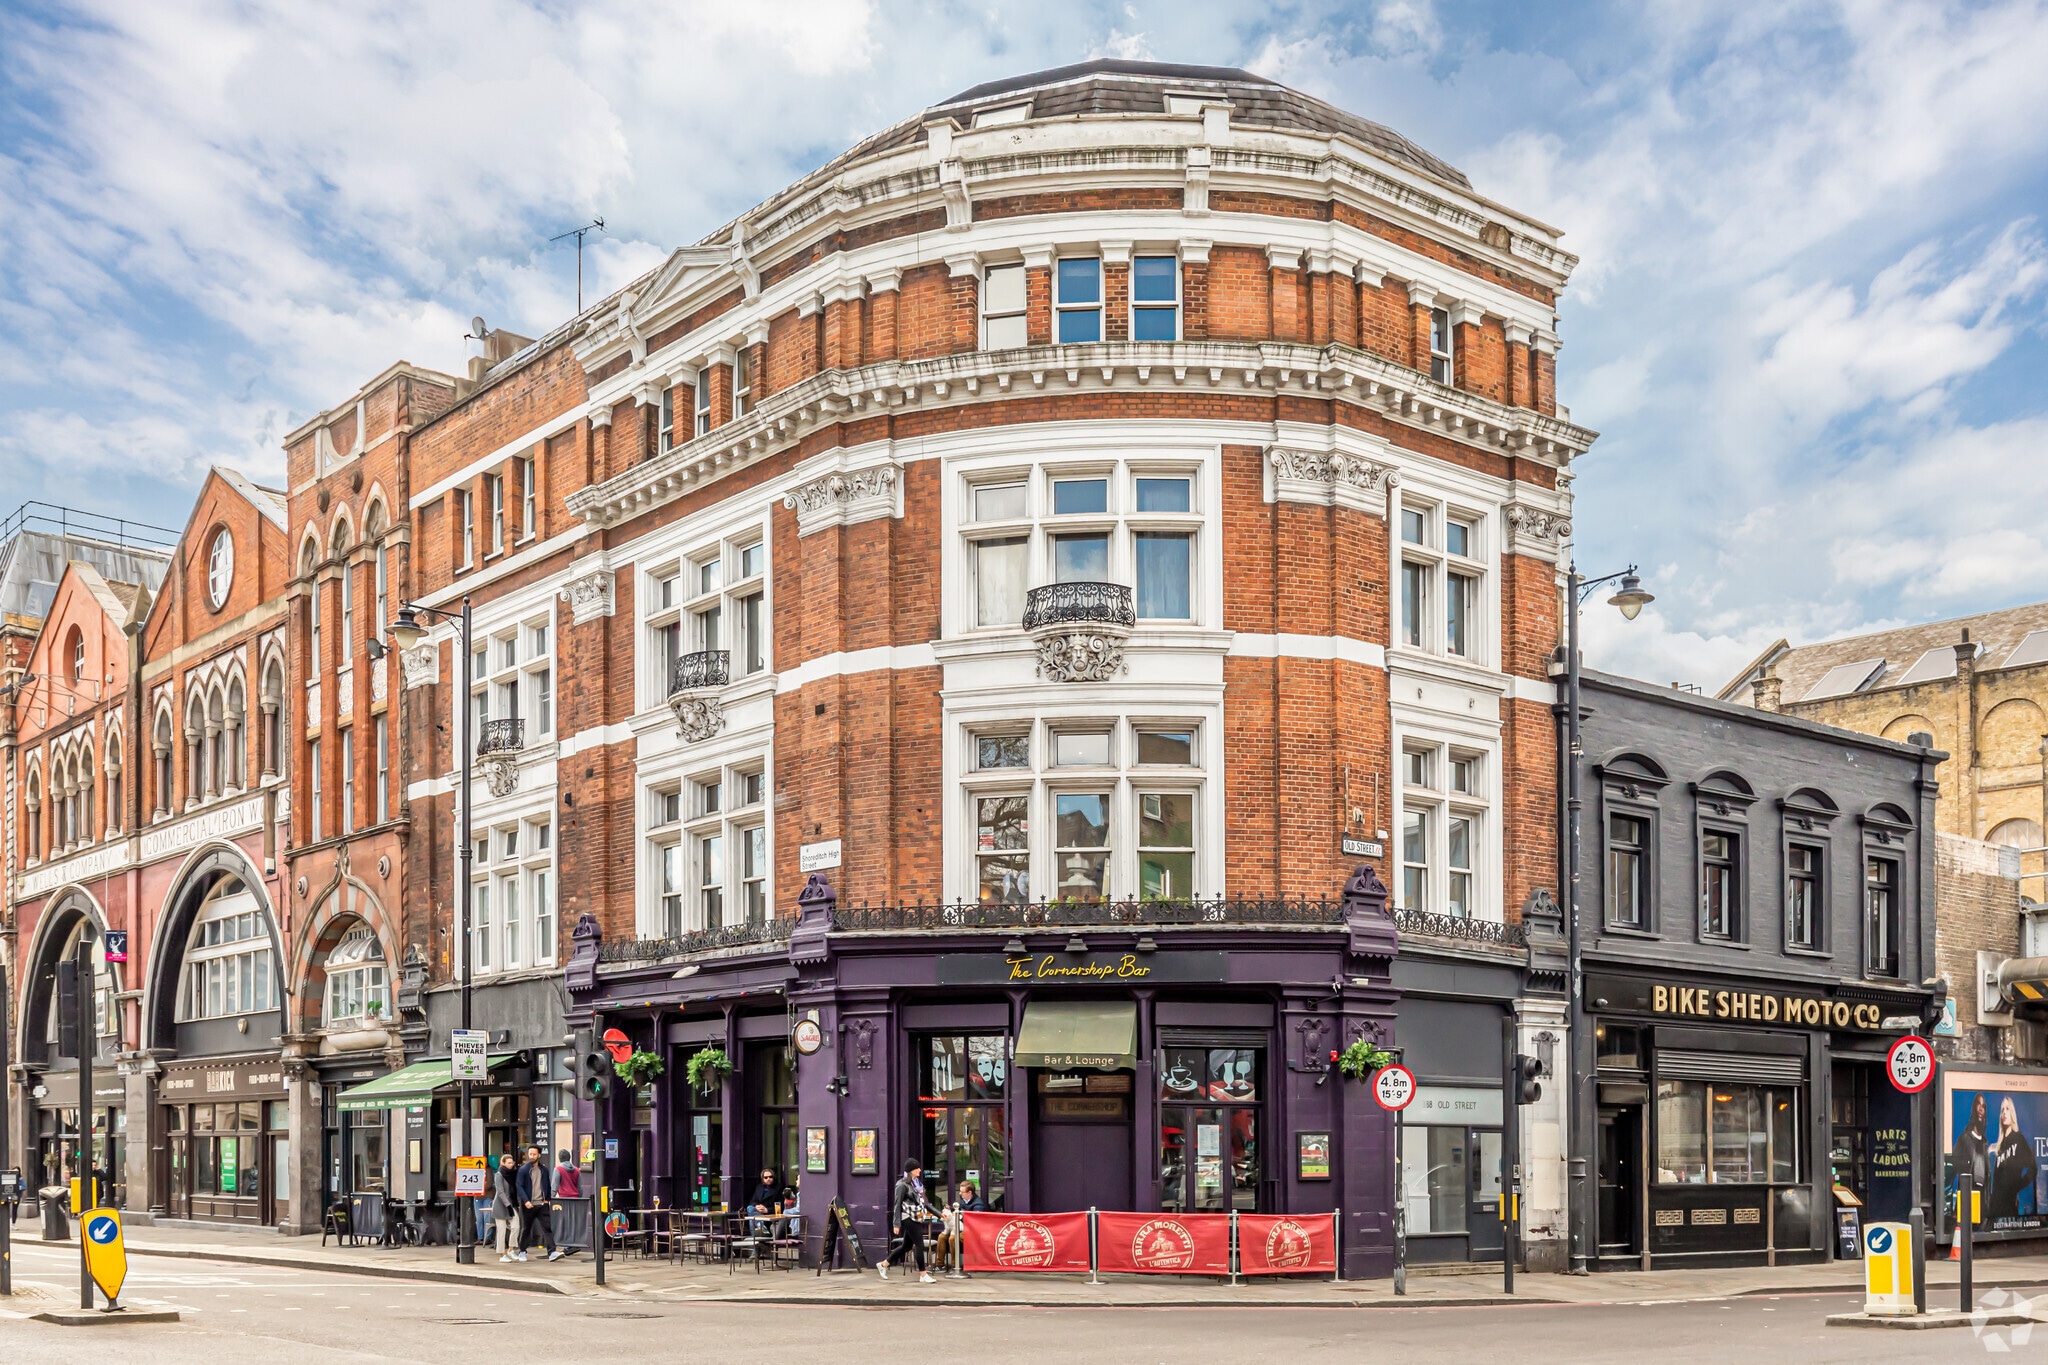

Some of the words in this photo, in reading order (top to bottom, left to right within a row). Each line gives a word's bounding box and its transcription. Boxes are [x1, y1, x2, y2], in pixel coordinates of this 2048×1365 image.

[146, 816, 214, 853] COMMERCIAL
[218, 806, 244, 832] IRON
[249, 791, 290, 823] WKS
[1345, 841, 1355, 850] OLD
[1356, 842, 1374, 853] STREET
[802, 852, 827, 862] Shoreditch
[828, 850, 839, 858] High
[32, 872, 59, 890] WELLS
[70, 850, 112, 879] COMPANY
[802, 862, 817, 870] Street
[1006, 957, 1033, 981] The
[1037, 955, 1115, 980] Cornershop
[1117, 954, 1151, 978] Bar
[1652, 985, 1710, 1015] BIKE
[1715, 990, 1779, 1021] SHED
[1044, 1055, 1061, 1064] Bar
[1065, 1056, 1073, 1064] &
[1076, 1056, 1114, 1066] Lounge
[1380, 1076, 1408, 1087] 4.8m
[1437, 1101, 1450, 1109] OLD
[1454, 1101, 1477, 1110] STREET
[1875, 1129, 1907, 1141] PARTS
[1873, 1153, 1911, 1166] LABOUR
[1996, 1143, 2018, 1168] DKNY
[462, 1175, 479, 1183] 243
[997, 1223, 1017, 1254] BIRRA
[1015, 1221, 1052, 1247] MORETTI
[1135, 1225, 1154, 1256] BIRRA
[1153, 1221, 1191, 1249] MORETTI
